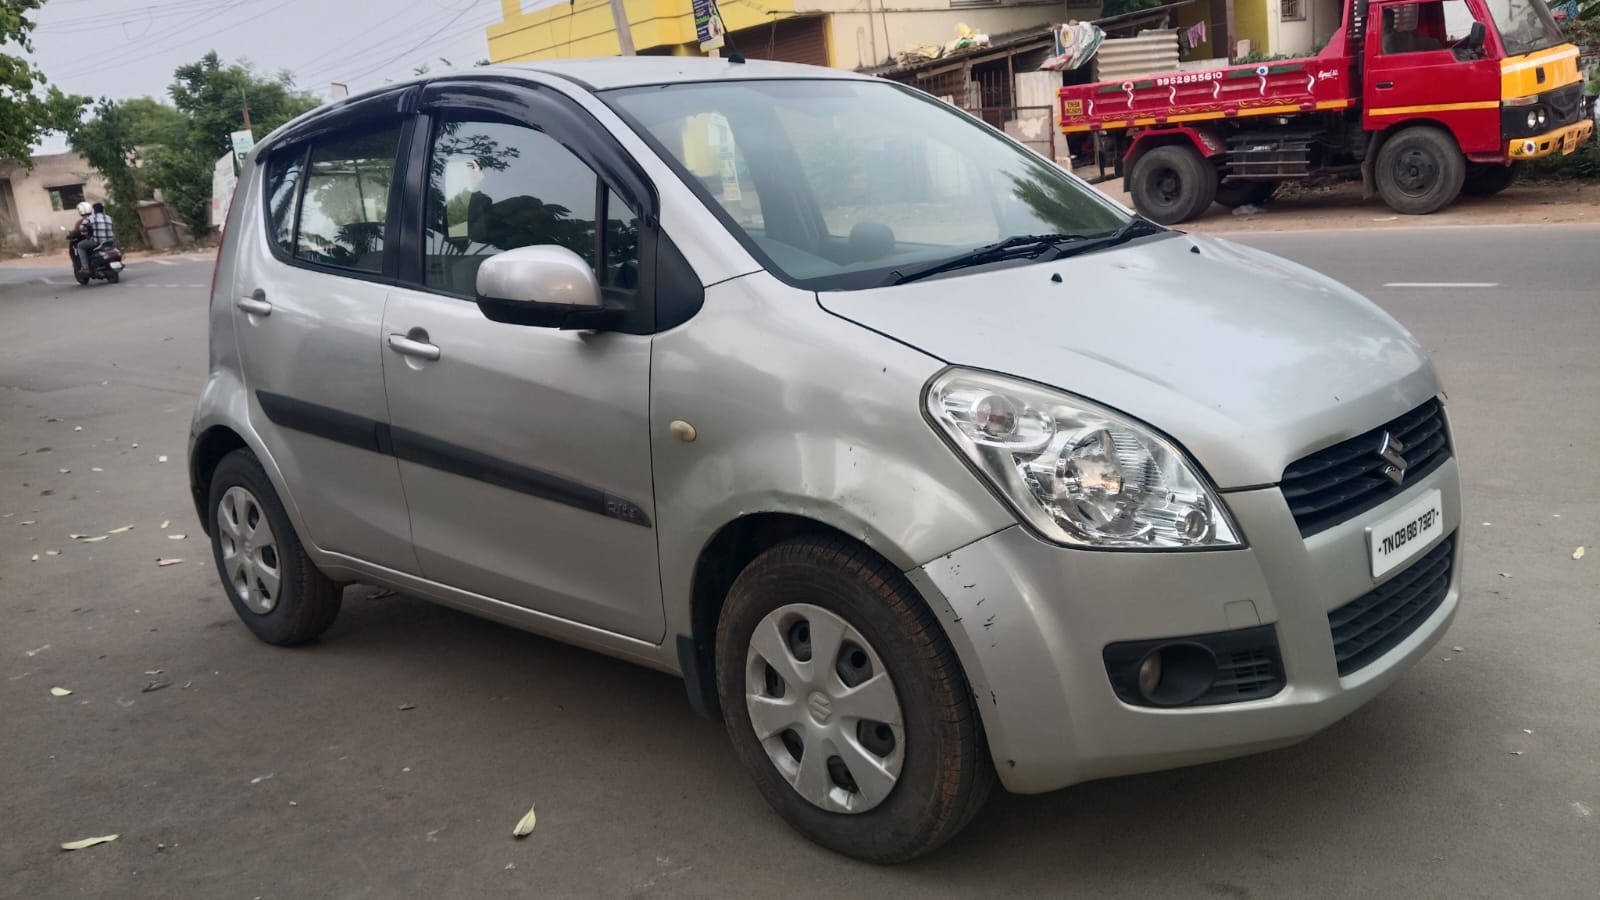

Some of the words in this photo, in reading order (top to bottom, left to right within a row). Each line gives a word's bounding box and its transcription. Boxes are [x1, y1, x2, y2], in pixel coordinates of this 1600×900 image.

[1382, 535, 1394, 555] TN
[1395, 528, 1406, 549] 09
[1418, 508, 1435, 535] 7327
